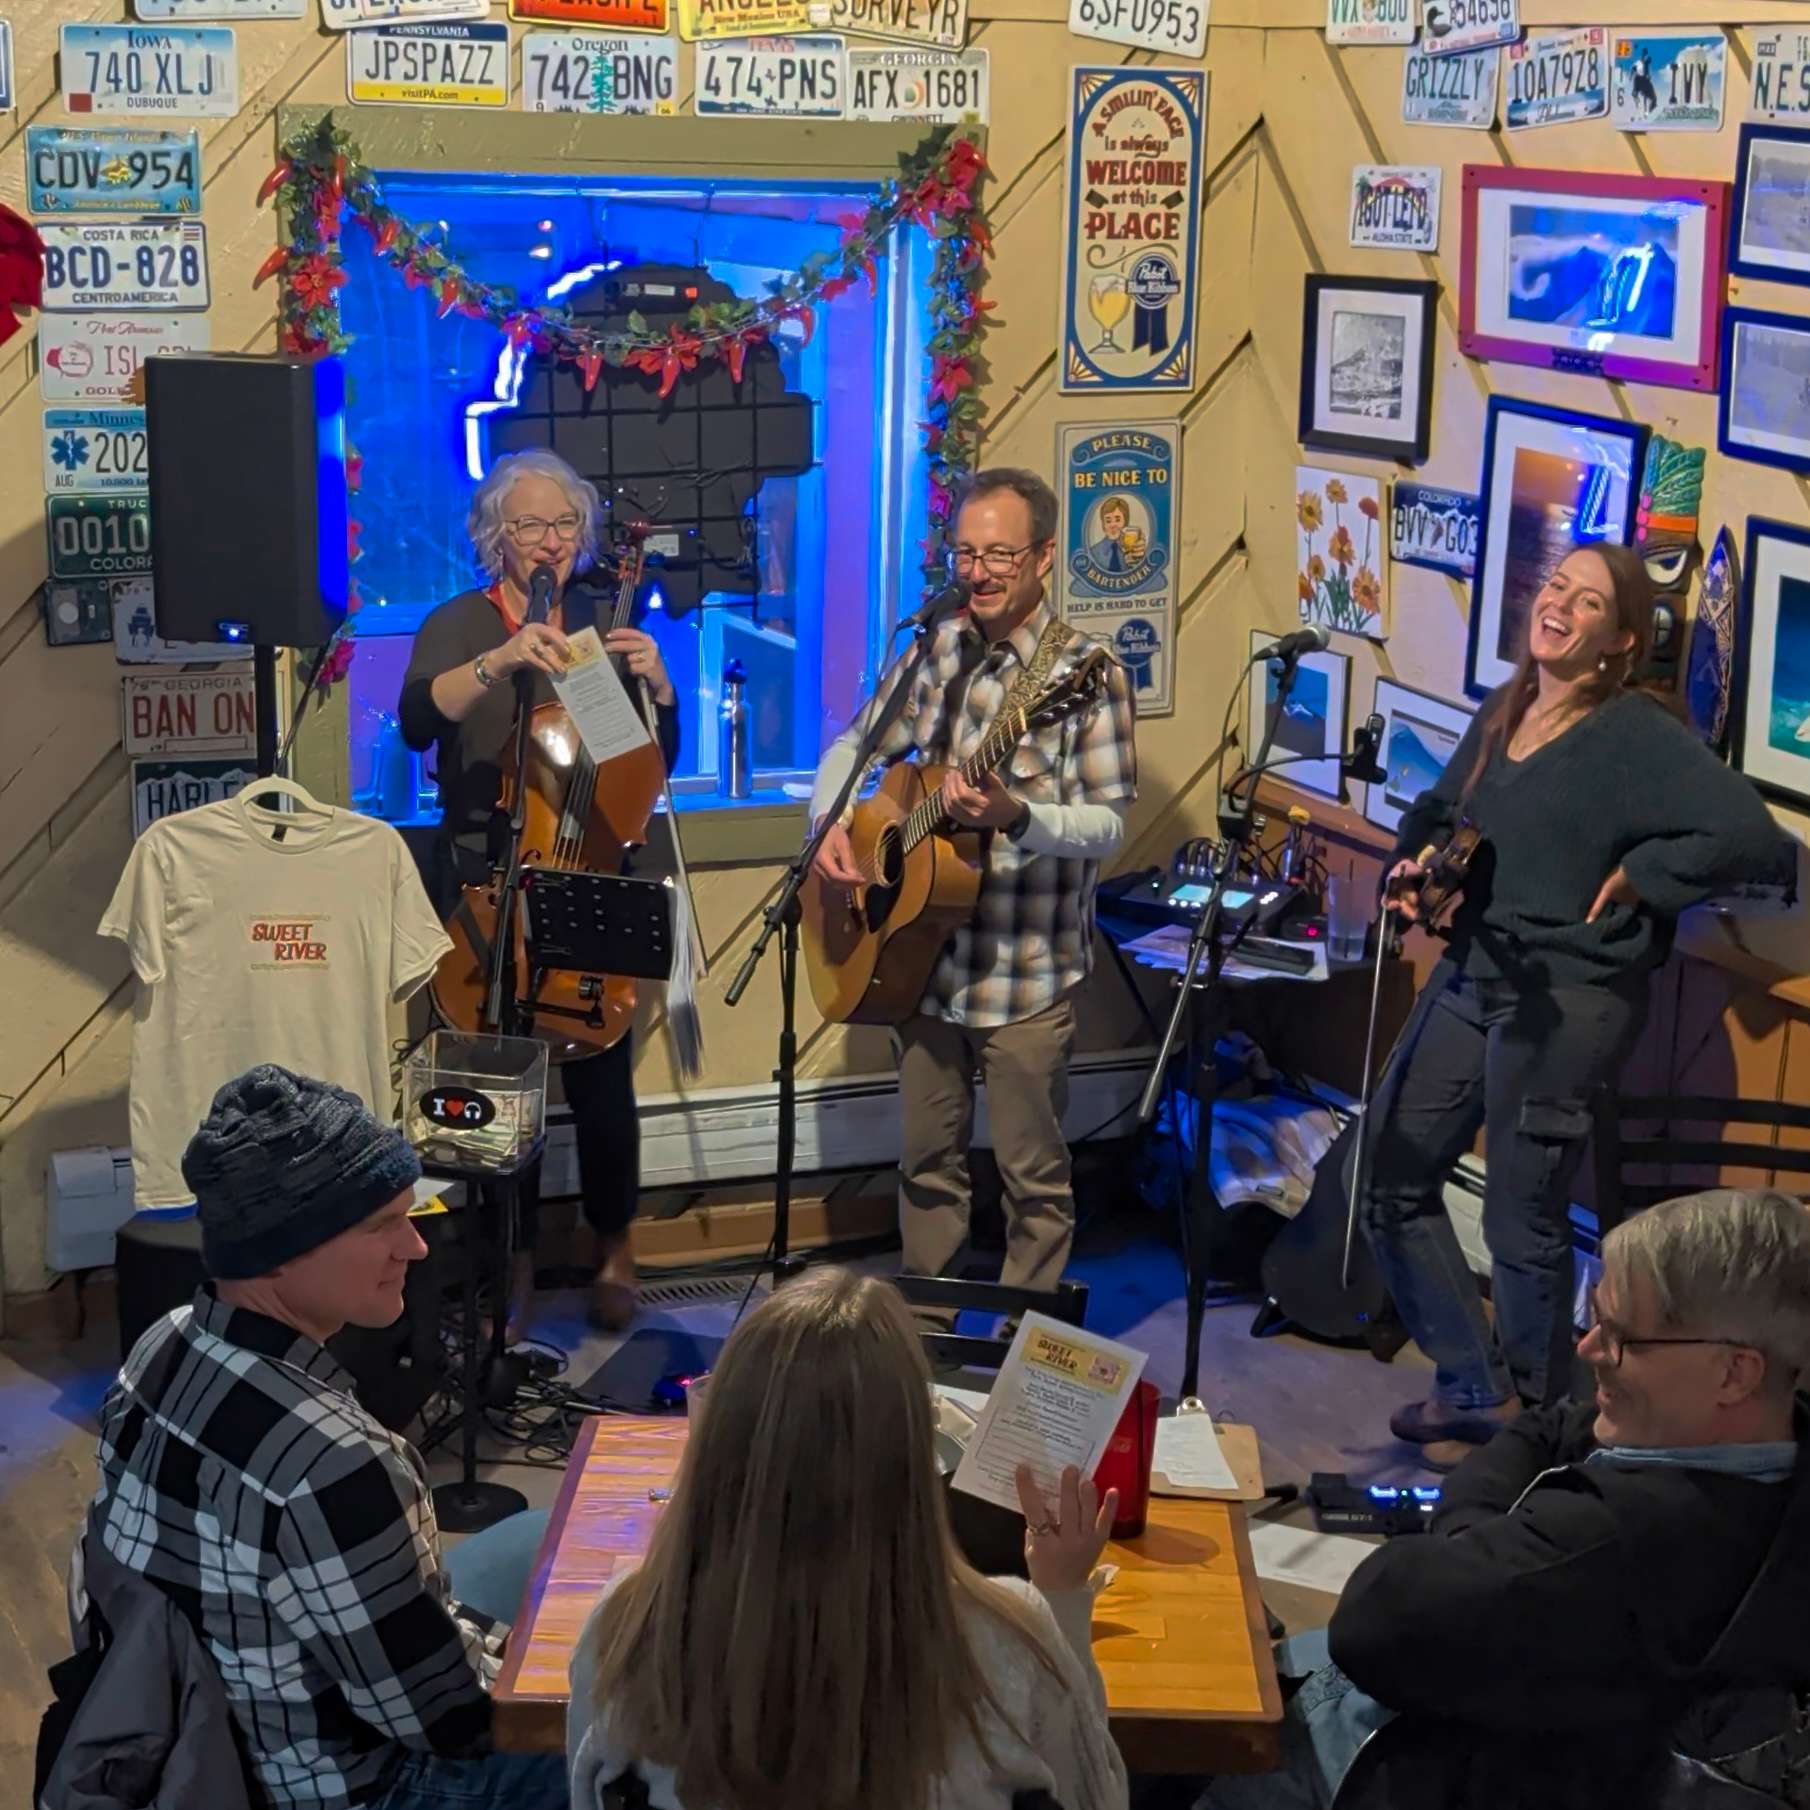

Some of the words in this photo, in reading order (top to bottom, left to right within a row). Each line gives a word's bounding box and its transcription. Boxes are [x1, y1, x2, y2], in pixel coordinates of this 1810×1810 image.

[572, 37, 628, 54] Oregon
[364, 40, 495, 85] JPSPAZZ
[880, 53, 958, 66] GEORGIA
[85, 51, 141, 94] 740
[156, 52, 213, 95] XLJ
[531, 54, 590, 100] 742
[613, 55, 672, 100] BNG
[705, 55, 762, 97] 474
[779, 58, 837, 100] PNS
[1406, 56, 1484, 101] GRIZZLY
[401, 88, 459, 100] visitPA.com
[853, 69, 899, 109] AFX
[923, 69, 979, 108] 1681
[1668, 63, 1707, 105] IVY
[126, 96, 178, 109] DUBUQUE
[1091, 122, 1106, 138] A
[1155, 97, 1184, 139] FACE
[1120, 134, 1170, 159] always
[35, 152, 100, 189] CDV
[128, 151, 194, 190] 954
[1086, 160, 1188, 186] WELCOME
[1111, 190, 1127, 204] at
[1130, 187, 1158, 208] this
[83, 229, 123, 241] COSTA
[130, 229, 160, 241] RICA
[1085, 211, 1181, 240] PLACE
[46, 245, 200, 289] BCD-828
[1137, 262, 1168, 280] Pabst
[72, 292, 178, 304] CENTROAMERICA
[94, 431, 148, 473] 202
[1092, 434, 1152, 452] PLEASE
[55, 474, 74, 488] AUG
[1074, 472, 1096, 488] BE
[1102, 471, 1140, 487] NICE
[1147, 468, 1167, 484] TO
[108, 499, 147, 509] TRUC
[1394, 505, 1428, 547] BVV
[1087, 565, 1152, 591] BARTENDER
[1067, 604, 1092, 614] HELP
[1095, 602, 1105, 611] IS
[1107, 600, 1133, 610] HARD
[1135, 599, 1147, 608] TO
[1149, 597, 1168, 608] GET
[1121, 626, 1151, 642] Pabst
[164, 677, 243, 691] GEORGIA
[132, 693, 196, 738] BAN
[213, 691, 254, 735] ON
[252, 922, 313, 942] SWEET
[274, 942, 327, 961] RIVER
[433, 1098, 445, 1116] I
